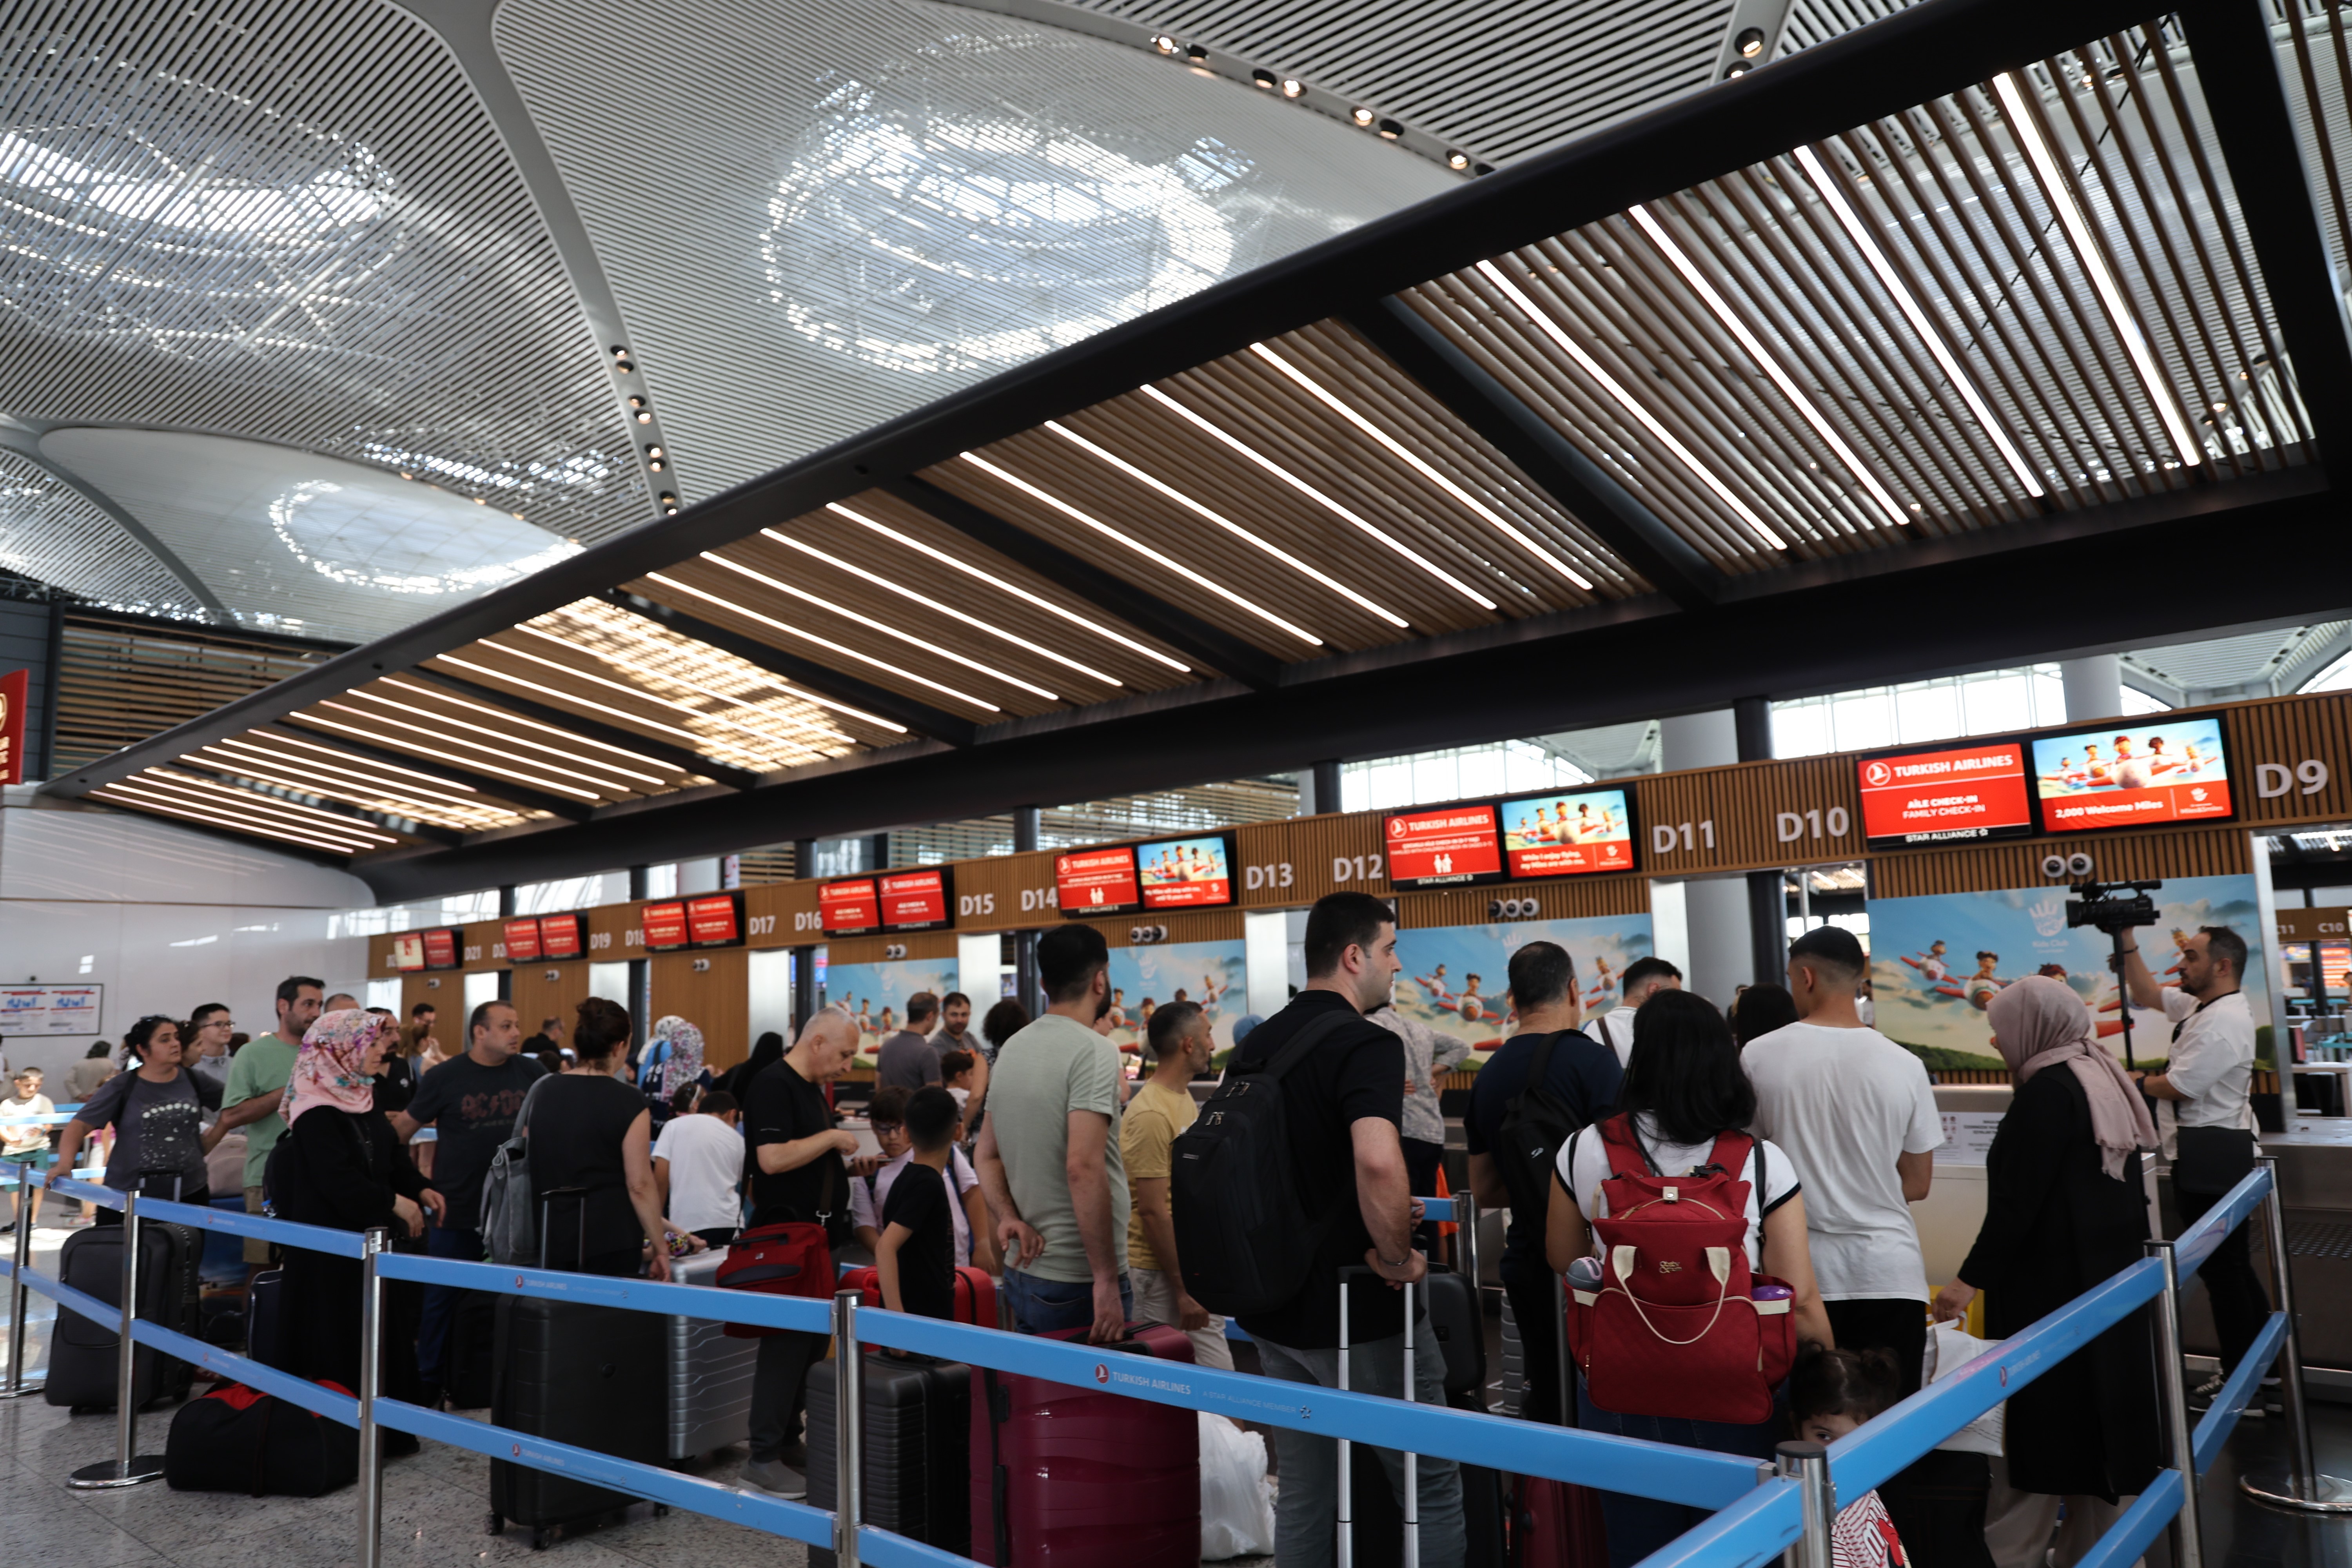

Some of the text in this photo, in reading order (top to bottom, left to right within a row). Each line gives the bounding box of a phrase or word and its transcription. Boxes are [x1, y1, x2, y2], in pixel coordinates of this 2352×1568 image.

[1894, 755, 2013, 778] TURKISH AIRLINES
[2256, 759, 2328, 798] D9
[1902, 809, 1937, 819] FAMILY
[2055, 800, 2163, 818] 2,000 Welcome Miles
[1408, 814, 1489, 831] TURKISH AIRLINES
[1777, 806, 1850, 842] D10
[1652, 820, 1715, 854] D11
[1905, 829, 1978, 843] STAR ALLIANCE
[1246, 862, 1293, 890] D13
[1333, 854, 1384, 883] D12
[960, 893, 995, 916] D15
[1021, 887, 1058, 912] D14
[749, 915, 776, 935] D17
[795, 911, 822, 931] D16
[2318, 922, 2345, 933] C10
[590, 932, 611, 950] D19
[465, 945, 482, 961] D21
[1112, 1372, 1191, 1395] TURKISH AIRLINES
